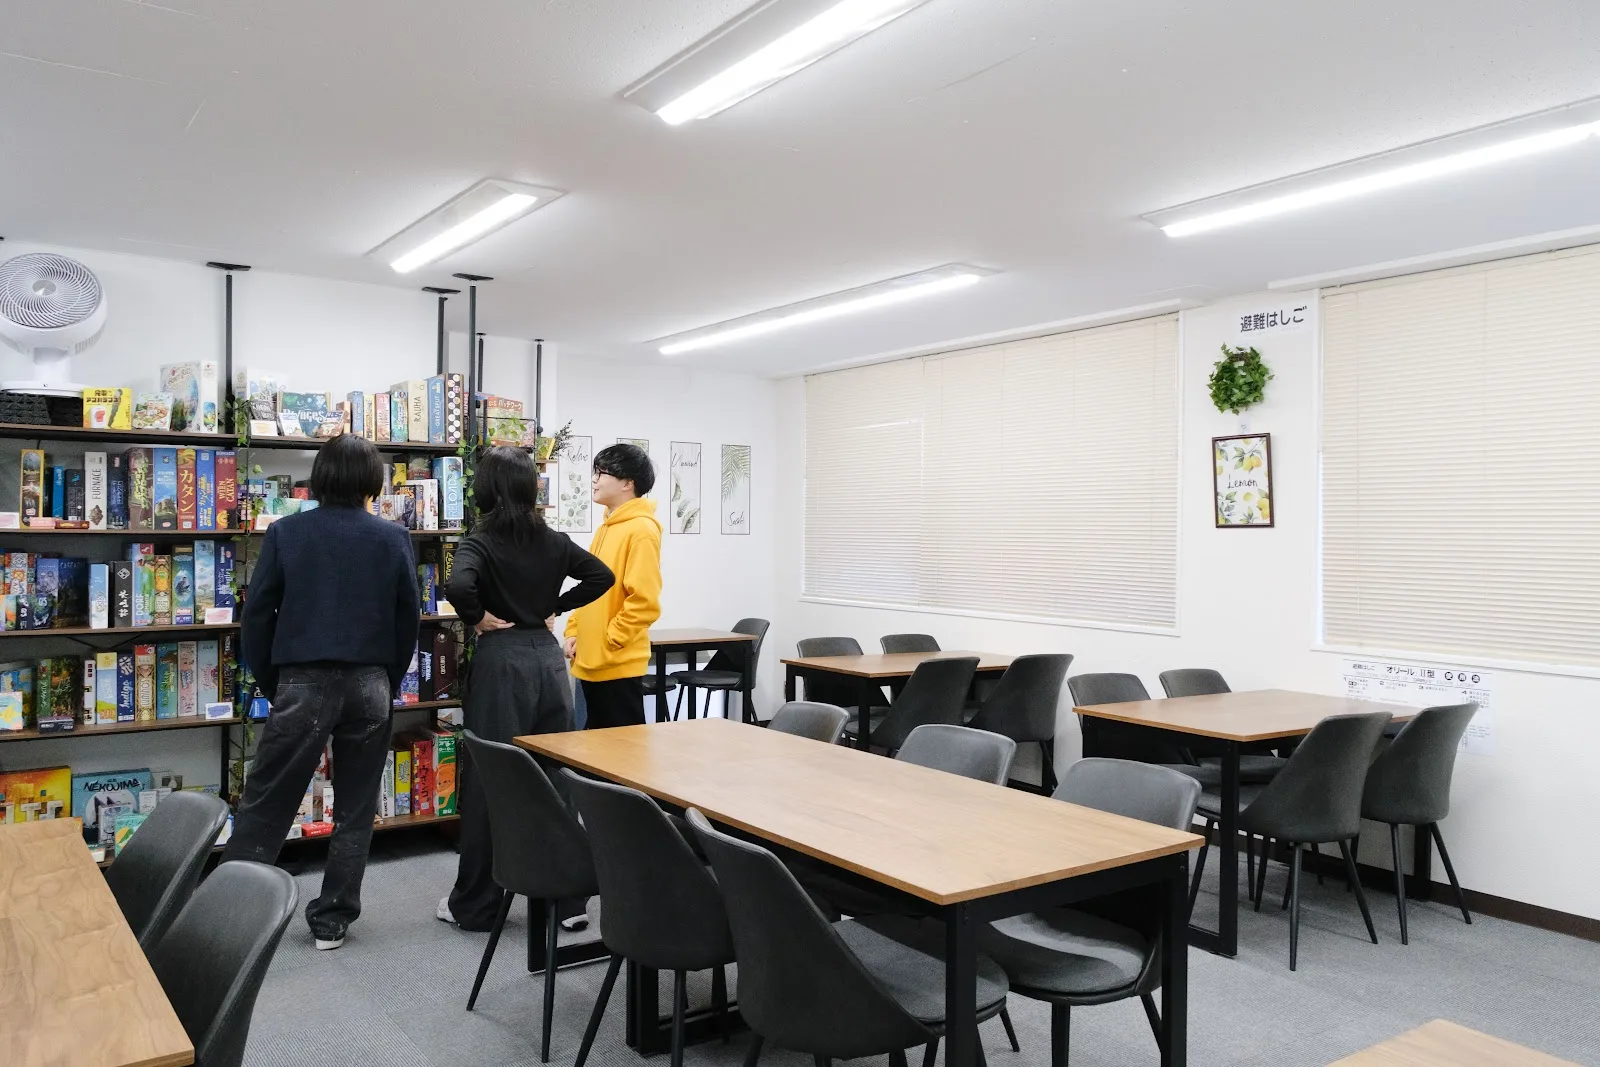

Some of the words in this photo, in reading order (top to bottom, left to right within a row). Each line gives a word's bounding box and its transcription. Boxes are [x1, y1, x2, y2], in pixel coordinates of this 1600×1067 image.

[1240, 305, 1308, 333] 避難はしご
[413, 396, 422, 422] RAUHA
[91, 468, 102, 500] FURNACE
[180, 469, 195, 512] カタン
[218, 480, 226, 499] WIEN
[226, 478, 235, 502] CATAN
[1227, 475, 1258, 489] Lemon
[135, 594, 144, 616] DORF
[1386, 666, 1415, 676] オリール
[119, 680, 131, 708] Indigo
